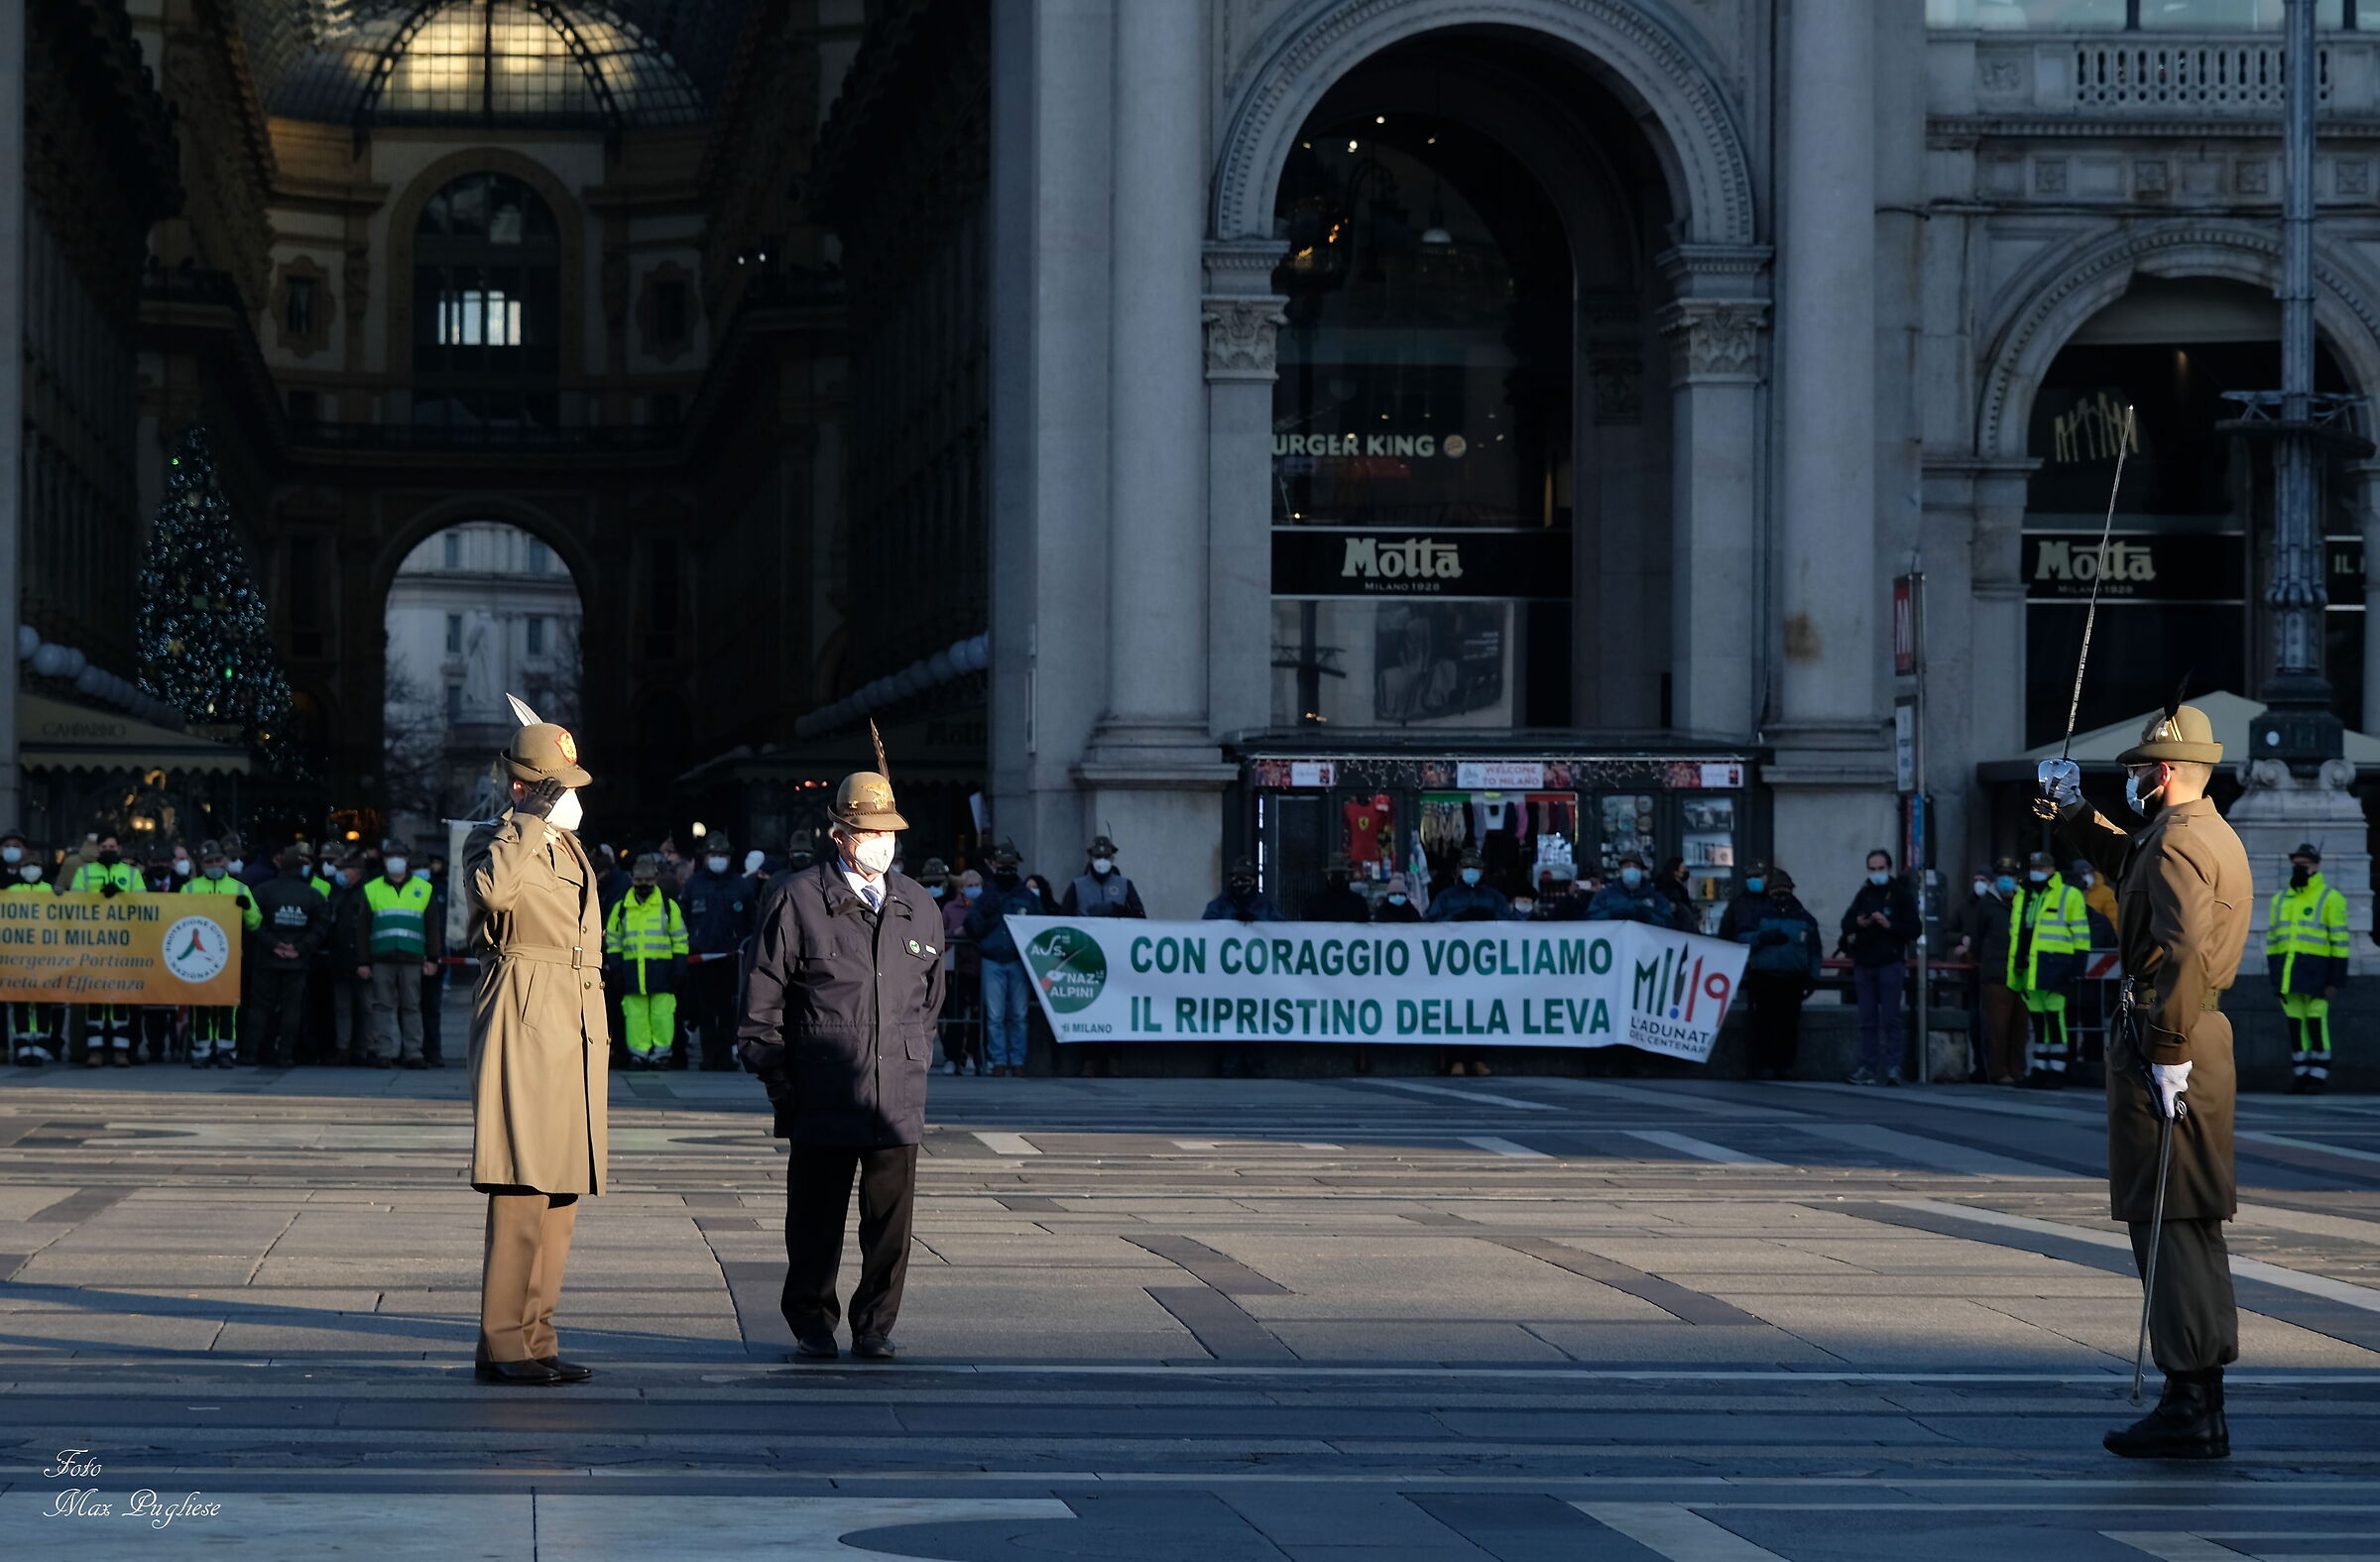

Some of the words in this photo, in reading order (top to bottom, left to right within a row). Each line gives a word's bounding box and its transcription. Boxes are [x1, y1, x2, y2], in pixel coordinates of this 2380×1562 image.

[1271, 433, 1360, 457] URGER
[1366, 433, 1437, 457] KING
[1341, 537, 1464, 579] Motta
[2032, 539, 2158, 582] Motta
[2333, 552, 2355, 574] IL
[1364, 580, 1411, 592] MILANO
[1486, 765, 1536, 775] WELCOME
[1483, 777, 1497, 786] TO
[1499, 777, 1540, 786] MILANO
[47, 903, 100, 920] CIVILE
[106, 904, 160, 921] ALPINI
[42, 929, 59, 945] DI
[65, 929, 131, 946] MILANO
[78, 952, 155, 968] Portiamo
[1130, 936, 1207, 975] CON
[1220, 937, 1409, 976] CORAGGIO
[1422, 938, 1613, 976] VOGLIAMO
[43, 975, 62, 990] ed
[66, 975, 146, 993] Efficienza
[1049, 985, 1095, 999] ALPINI
[1130, 996, 1162, 1032] IL
[1175, 997, 1382, 1035] RIPRISTINO
[1396, 999, 1510, 1035] DELLA
[1522, 999, 1610, 1034] LEVA
[1072, 1022, 1113, 1033] MILANO
[1629, 1029, 1645, 1042] DEL
[1630, 1016, 1711, 1044] L'ADUNAT
